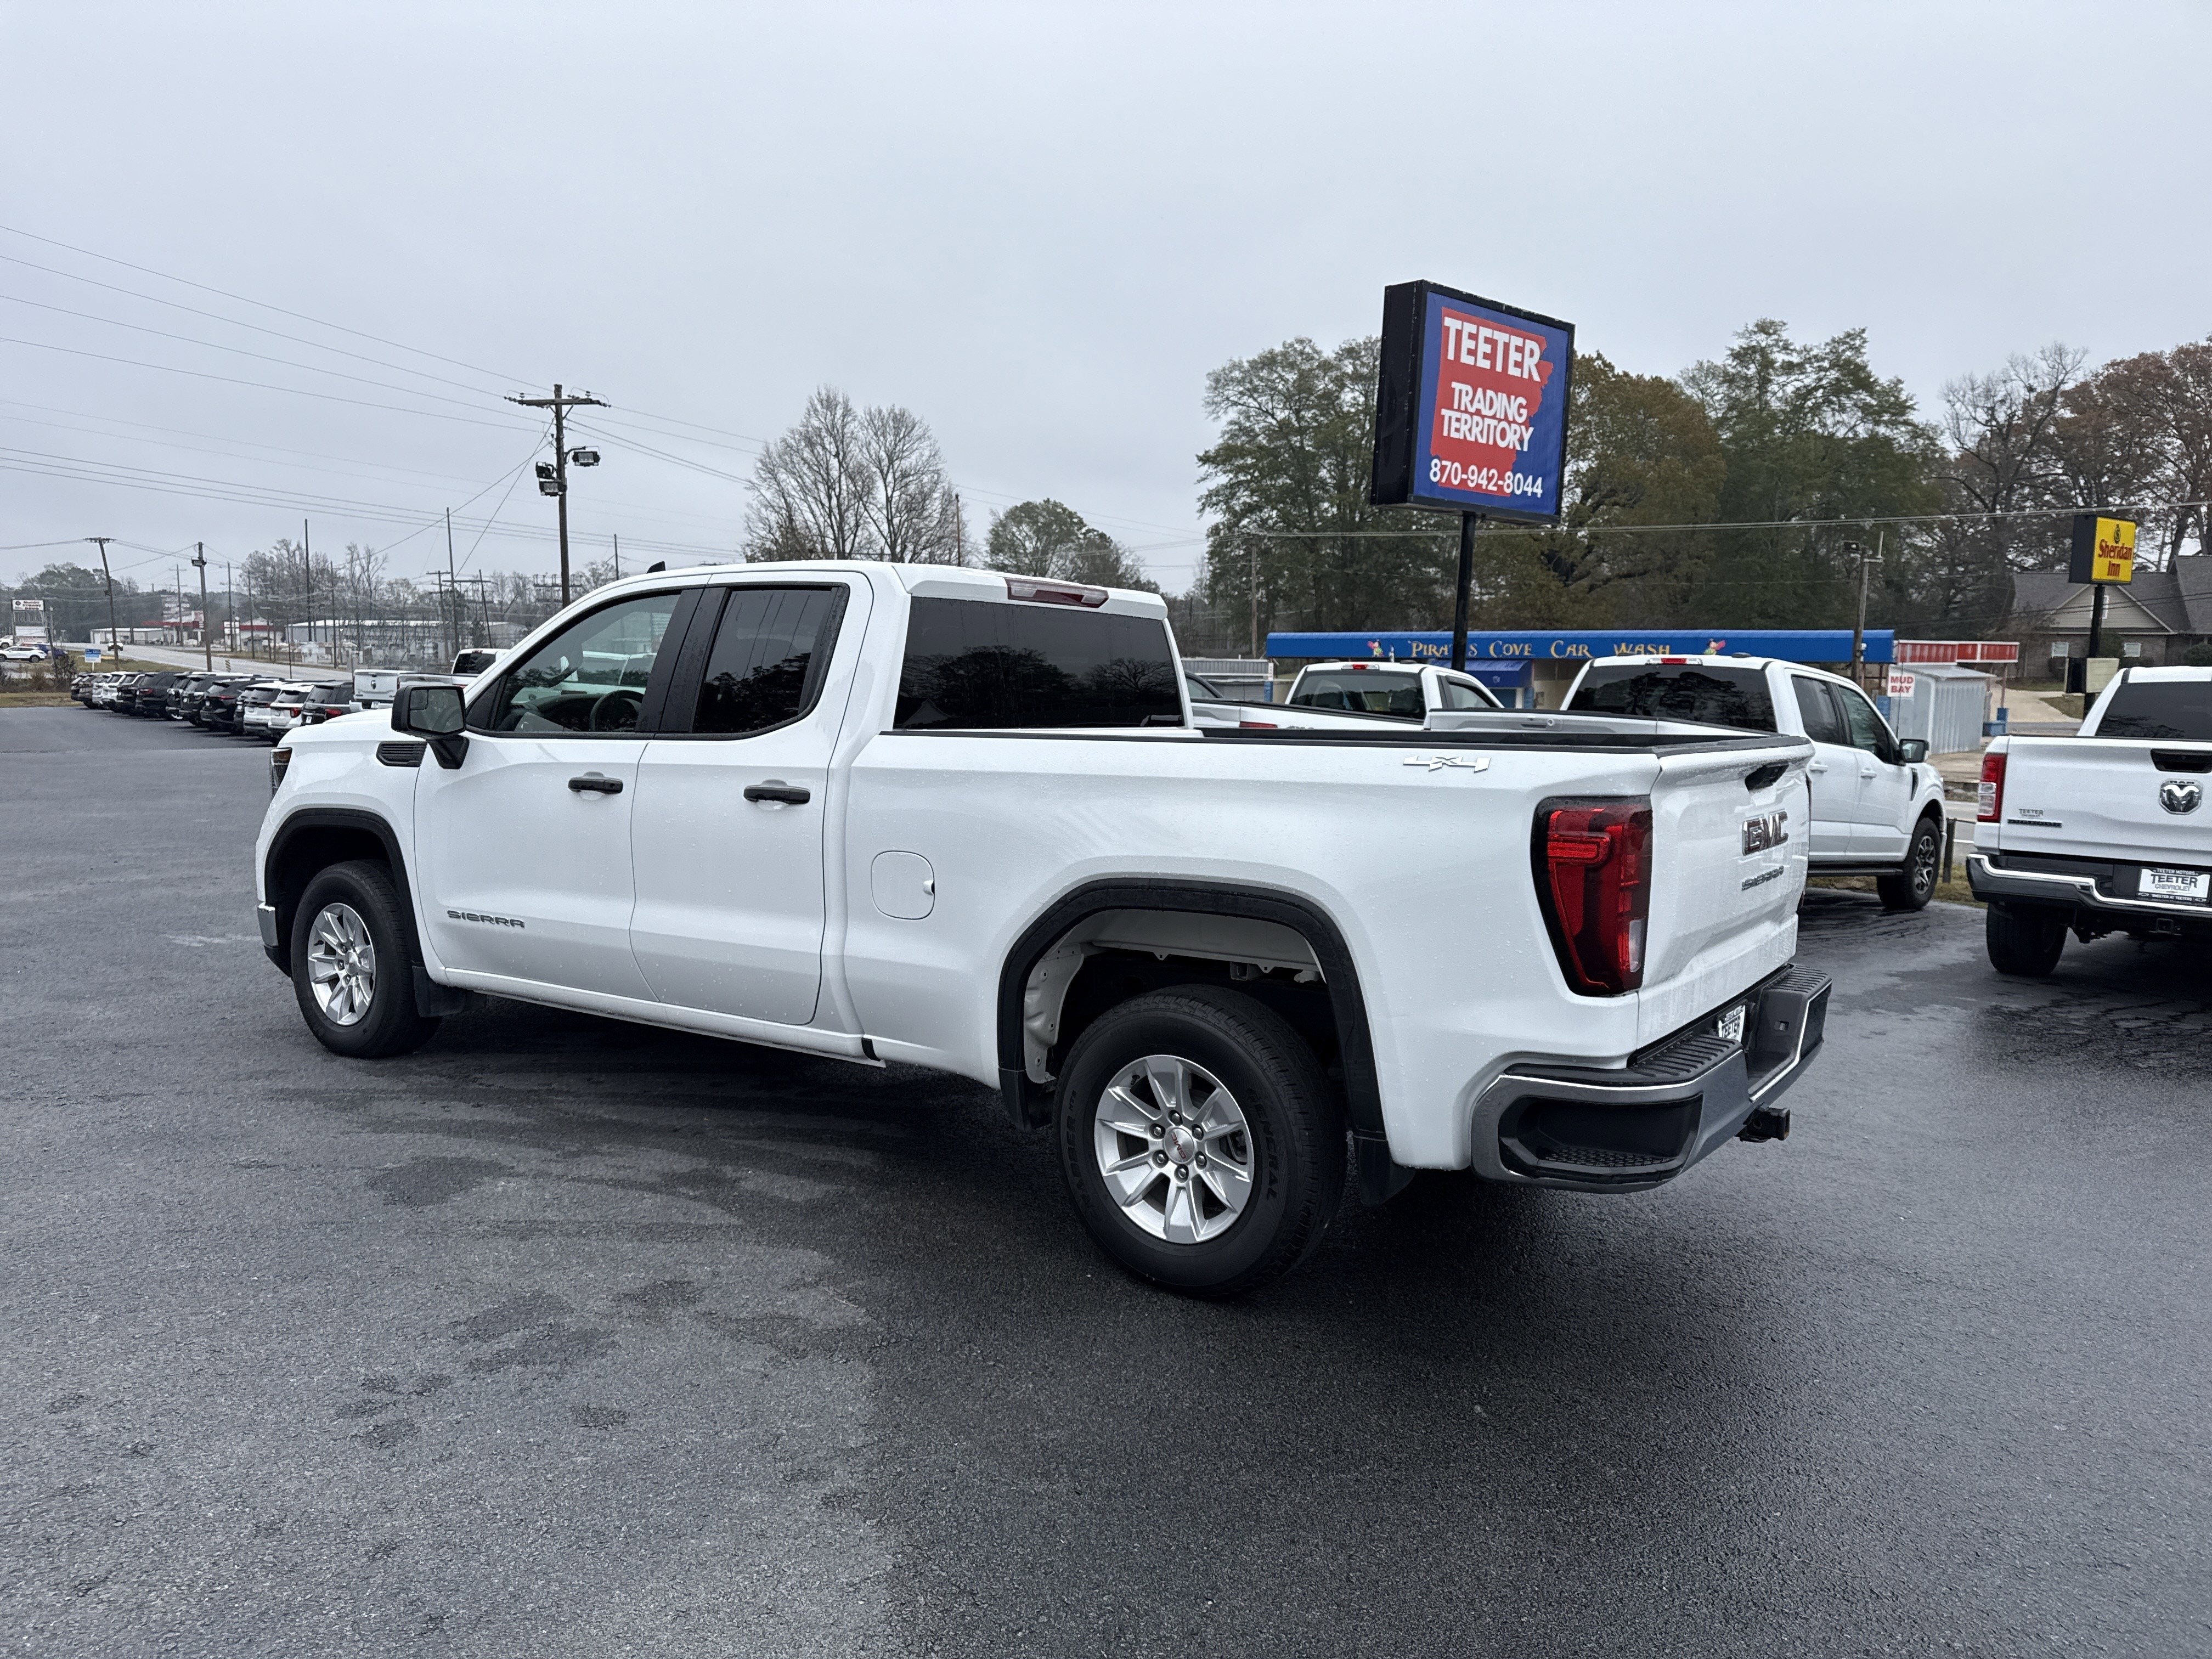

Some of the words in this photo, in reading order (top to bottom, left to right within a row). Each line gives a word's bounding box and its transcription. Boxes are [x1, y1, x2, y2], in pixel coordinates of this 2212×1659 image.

[1444, 317, 1541, 382] TEETER
[1451, 381, 1528, 424] TRADING
[1441, 409, 1534, 452] TERRITORY
[1429, 458, 1543, 498] 870-942-8044
[2098, 539, 2132, 560] Sheridan
[2107, 560, 2121, 577] Inn
[1488, 640, 1534, 658] COVE
[1550, 640, 1594, 658] CAR
[1613, 642, 1671, 656] WASH
[1890, 676, 1914, 684] MUD
[1891, 685, 1911, 693] BAY
[1742, 810, 1789, 856] GMC
[2151, 873, 2198, 888] TEETER
[2154, 883, 2192, 891] CHEVROLET
[447, 910, 525, 928] SIERRA
[1171, 1132, 1187, 1159] GMC
